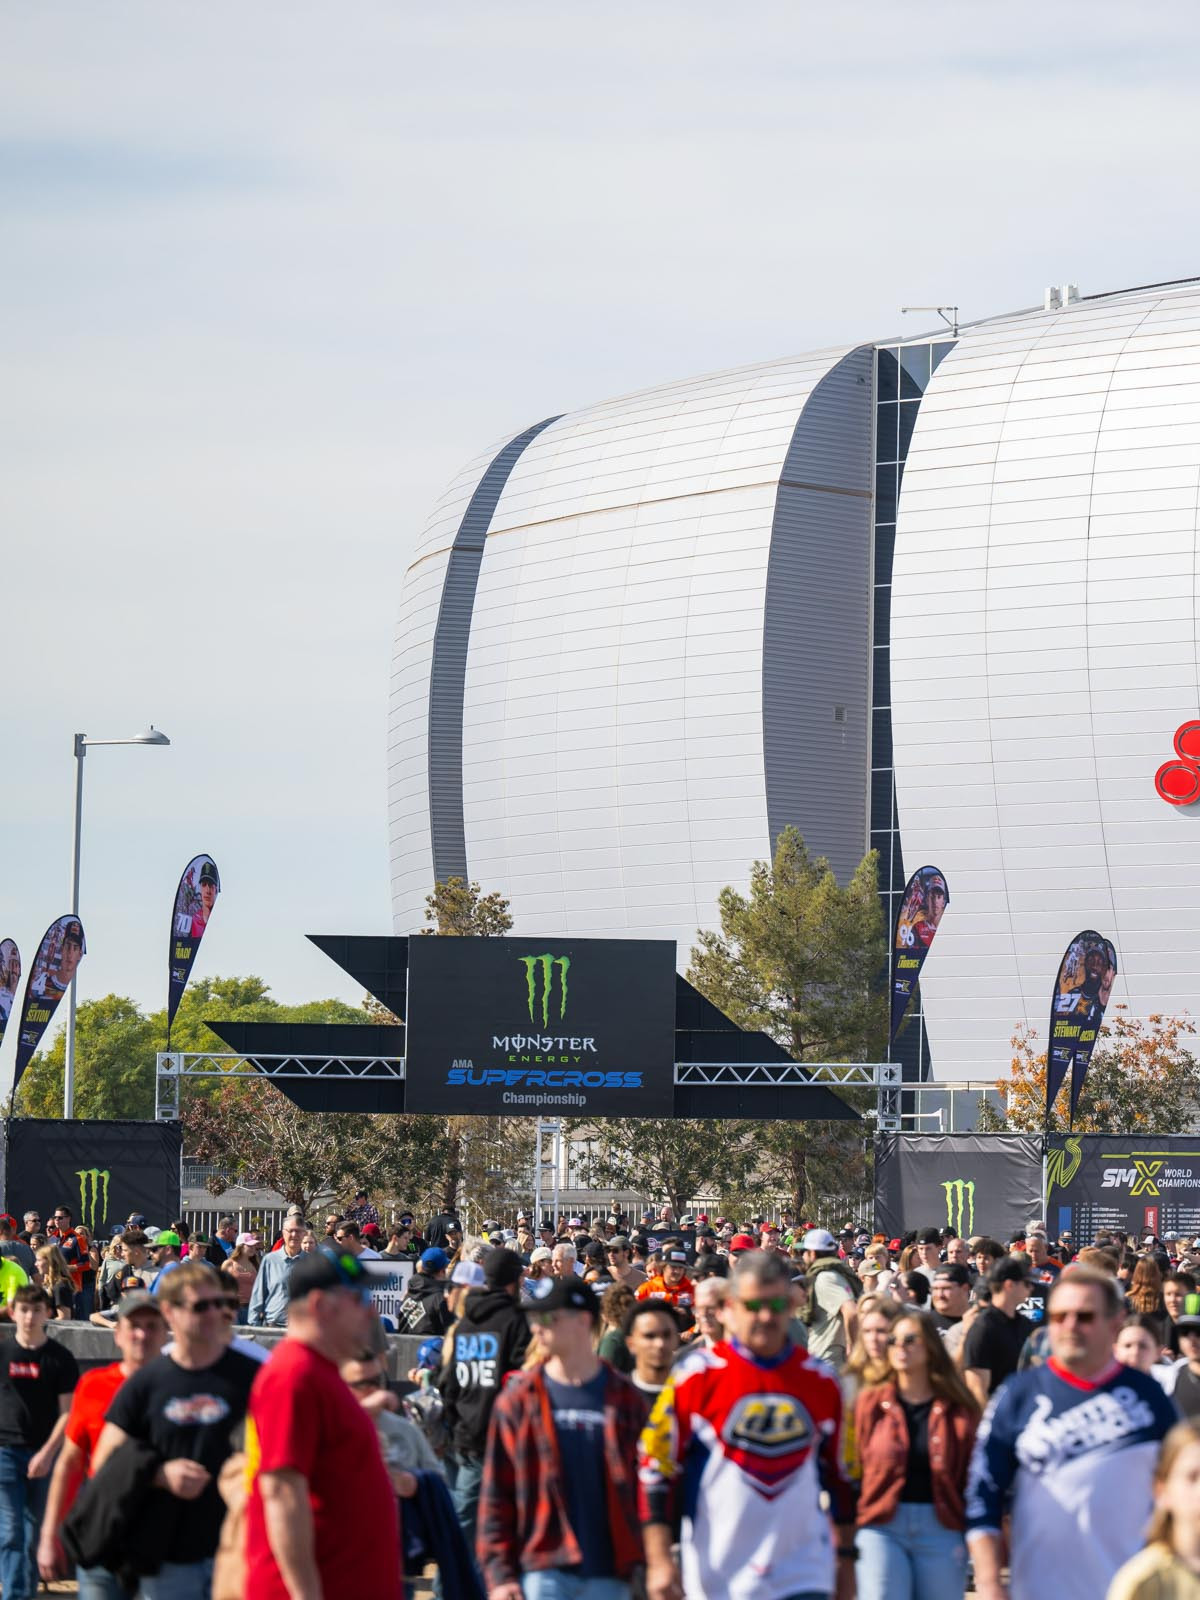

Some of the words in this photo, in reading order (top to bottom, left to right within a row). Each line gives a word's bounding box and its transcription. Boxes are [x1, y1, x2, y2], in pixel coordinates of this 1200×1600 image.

[900, 924, 915, 946] 96
[31, 972, 48, 995] 4
[1056, 993, 1081, 1012] 27
[1053, 1026, 1081, 1037] STEWART
[493, 1034, 598, 1052] MONSTER
[452, 1059, 473, 1068] AMA
[509, 1055, 581, 1063] ENERGY
[445, 1069, 644, 1088] SUPERCROSS
[503, 1092, 587, 1106] Championship
[1101, 1160, 1164, 1195] SMX
[1164, 1169, 1192, 1178] WORLD
[456, 1333, 498, 1361] BAD
